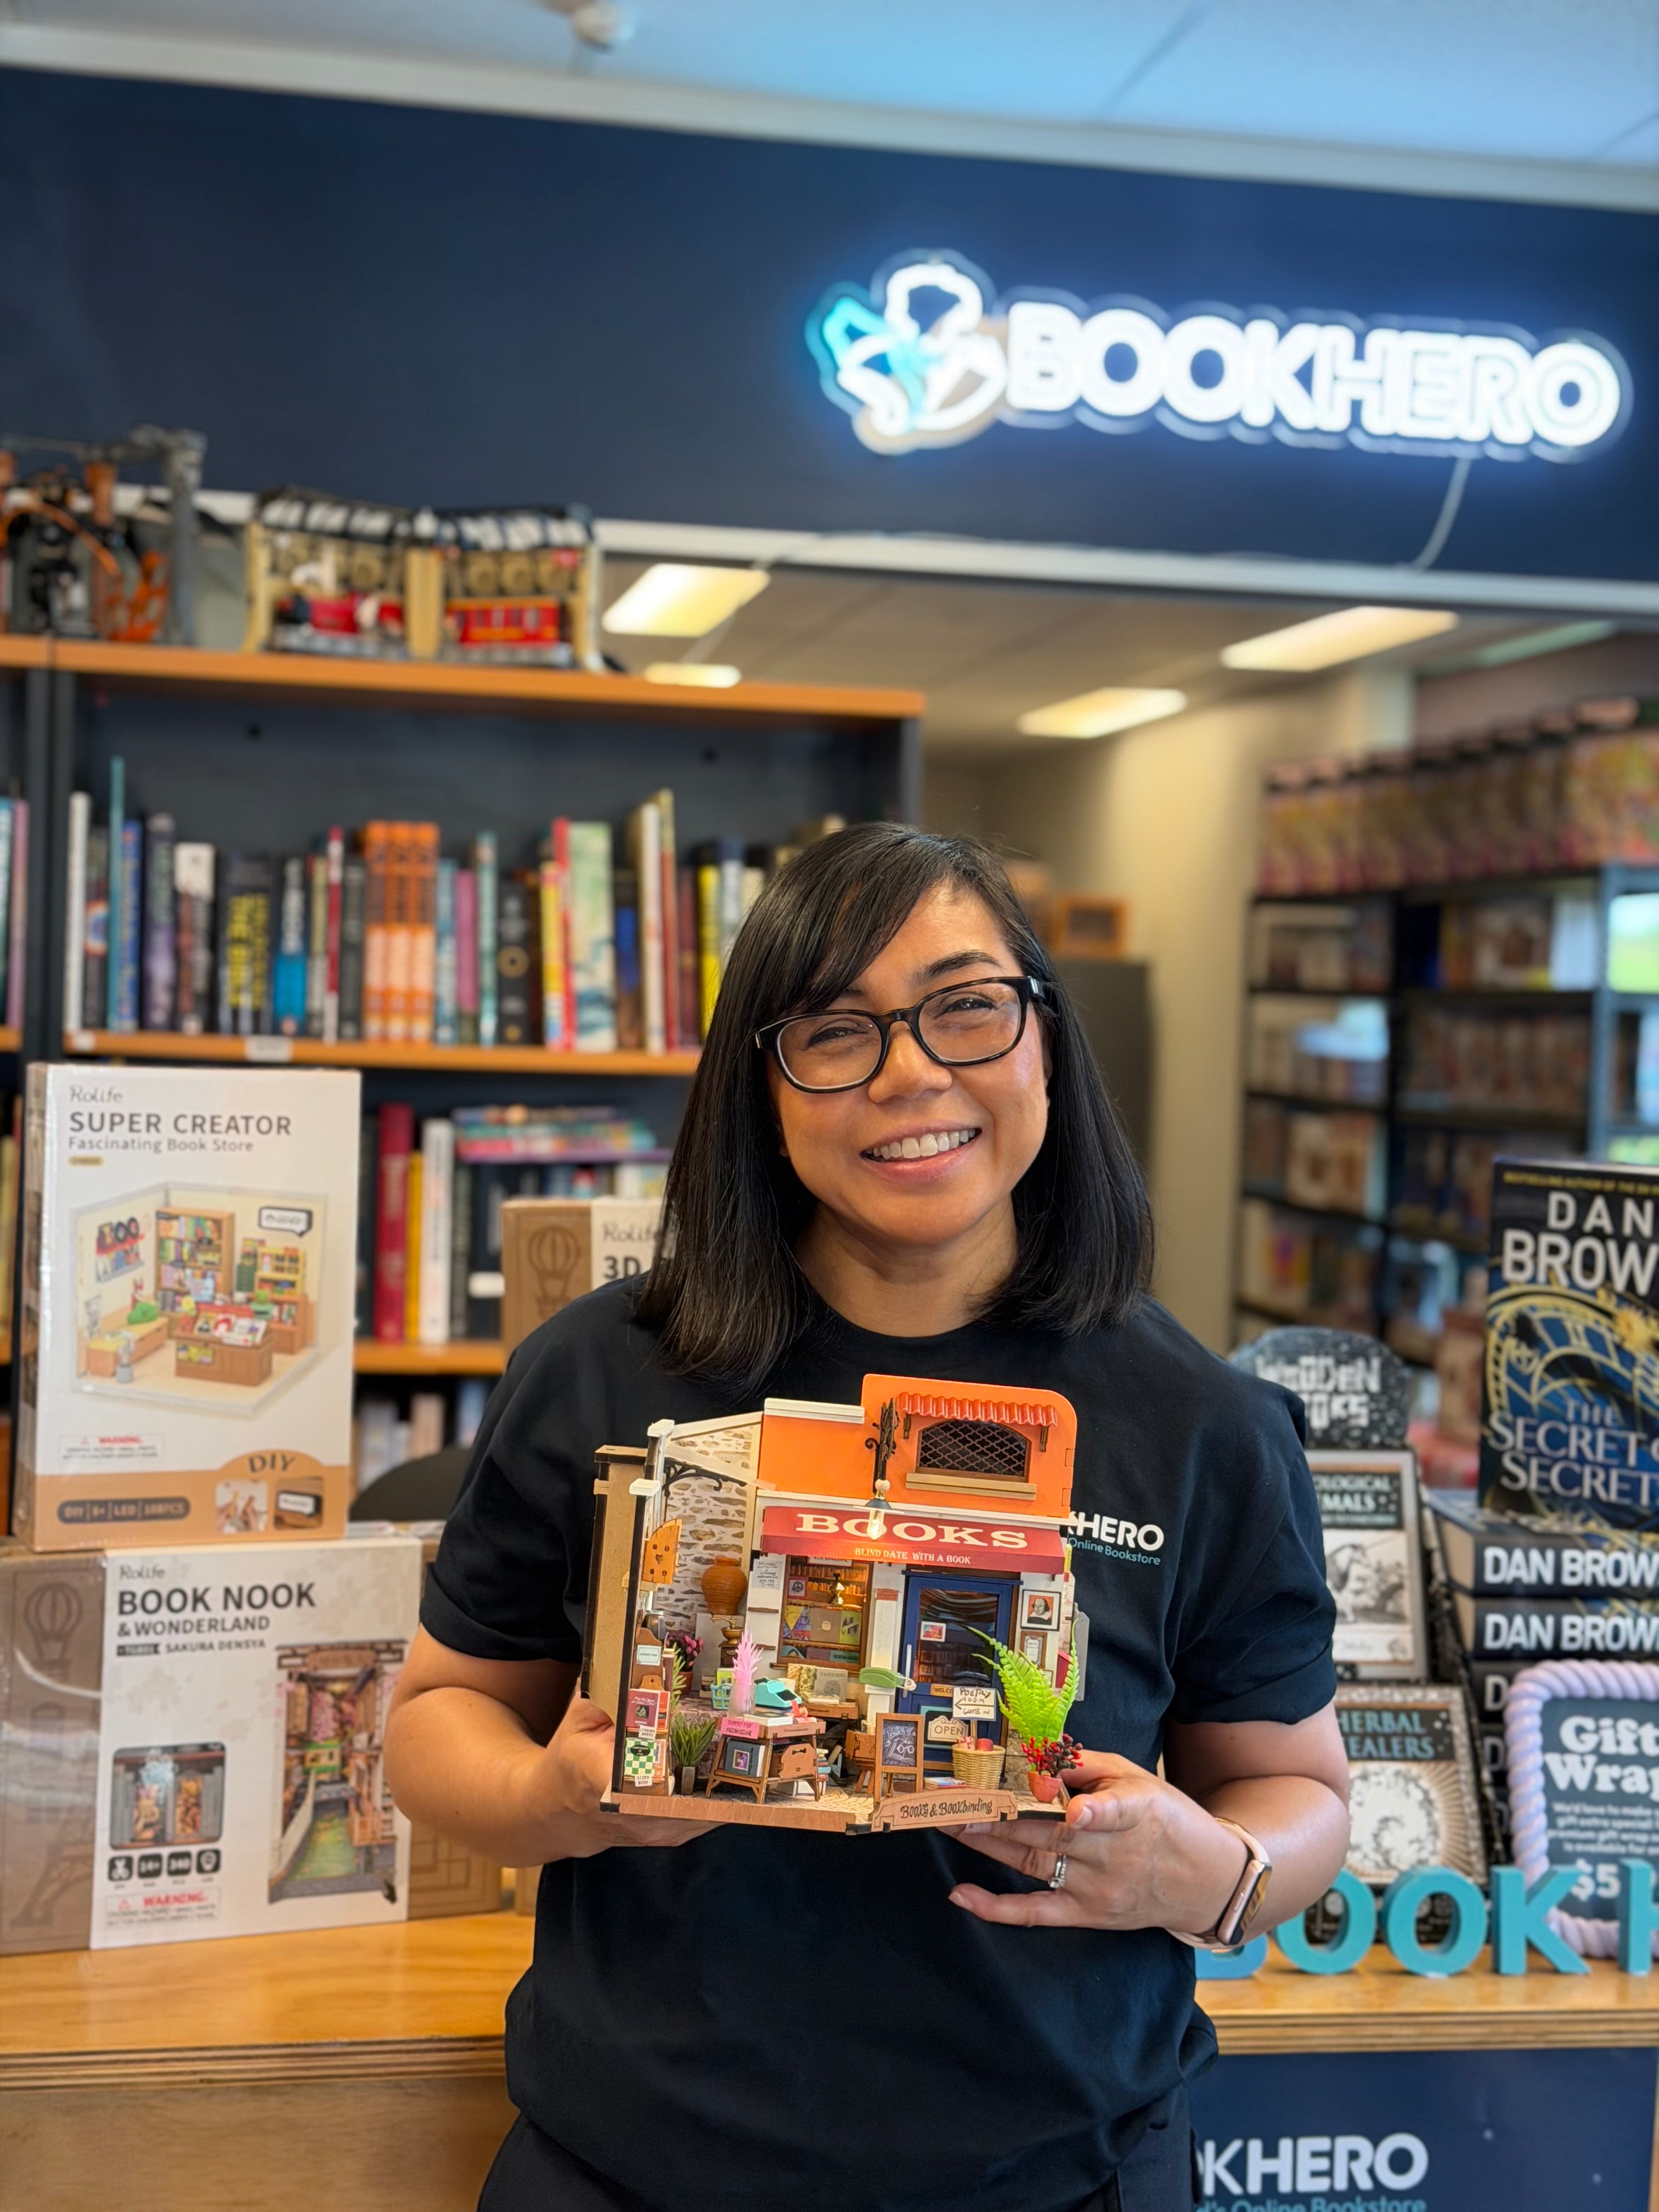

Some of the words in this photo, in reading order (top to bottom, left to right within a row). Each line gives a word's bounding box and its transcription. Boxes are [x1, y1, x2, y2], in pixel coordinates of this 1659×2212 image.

[1005, 300, 1622, 447] BOOKHERO
[70, 1111, 161, 1133] SUPER
[173, 1114, 291, 1135] CREATOR
[69, 1137, 162, 1153] Fascinating
[167, 1138, 207, 1152] Book
[213, 1139, 253, 1152] Store
[1547, 1190, 1654, 1238] DAN
[603, 1221, 656, 1243] Rolif
[604, 1256, 641, 1279] 3D
[1567, 1400, 1615, 1426] THE
[1488, 1408, 1649, 1468] SECRET
[248, 1454, 295, 1473] DIY
[1317, 1492, 1377, 1512] MALS
[795, 1513, 1029, 1550] BOOKS
[854, 1547, 882, 1559] BLIND
[883, 1548, 909, 1561] DATE
[912, 1550, 935, 1563] WITH
[936, 1553, 945, 1563] A
[946, 1554, 972, 1565] BOOK
[1068, 1537, 1104, 1553] Online
[1105, 1545, 1161, 1565] Bookstore
[1483, 1547, 1555, 1585] DAN
[1561, 1548, 1659, 1588] BROW
[117, 1587, 211, 1616] BOOK
[223, 1581, 316, 1612] NOOK
[117, 1622, 131, 1638] &
[134, 1616, 271, 1637] WONDERLAND
[1483, 1613, 1555, 1650] DAN
[1561, 1614, 1659, 1652] BROW
[166, 1641, 215, 1654] SAKURA
[218, 1639, 266, 1651] DENSYA
[960, 1687, 991, 1699] POETRY
[934, 1725, 964, 1735] OPEN
[1338, 1709, 1428, 1735] HERBAL
[1347, 1735, 1435, 1759] EALERS
[1559, 1715, 1659, 1757] Gift
[929, 1805, 938, 1818] &
[1197, 2132, 1429, 2196] KHERO
